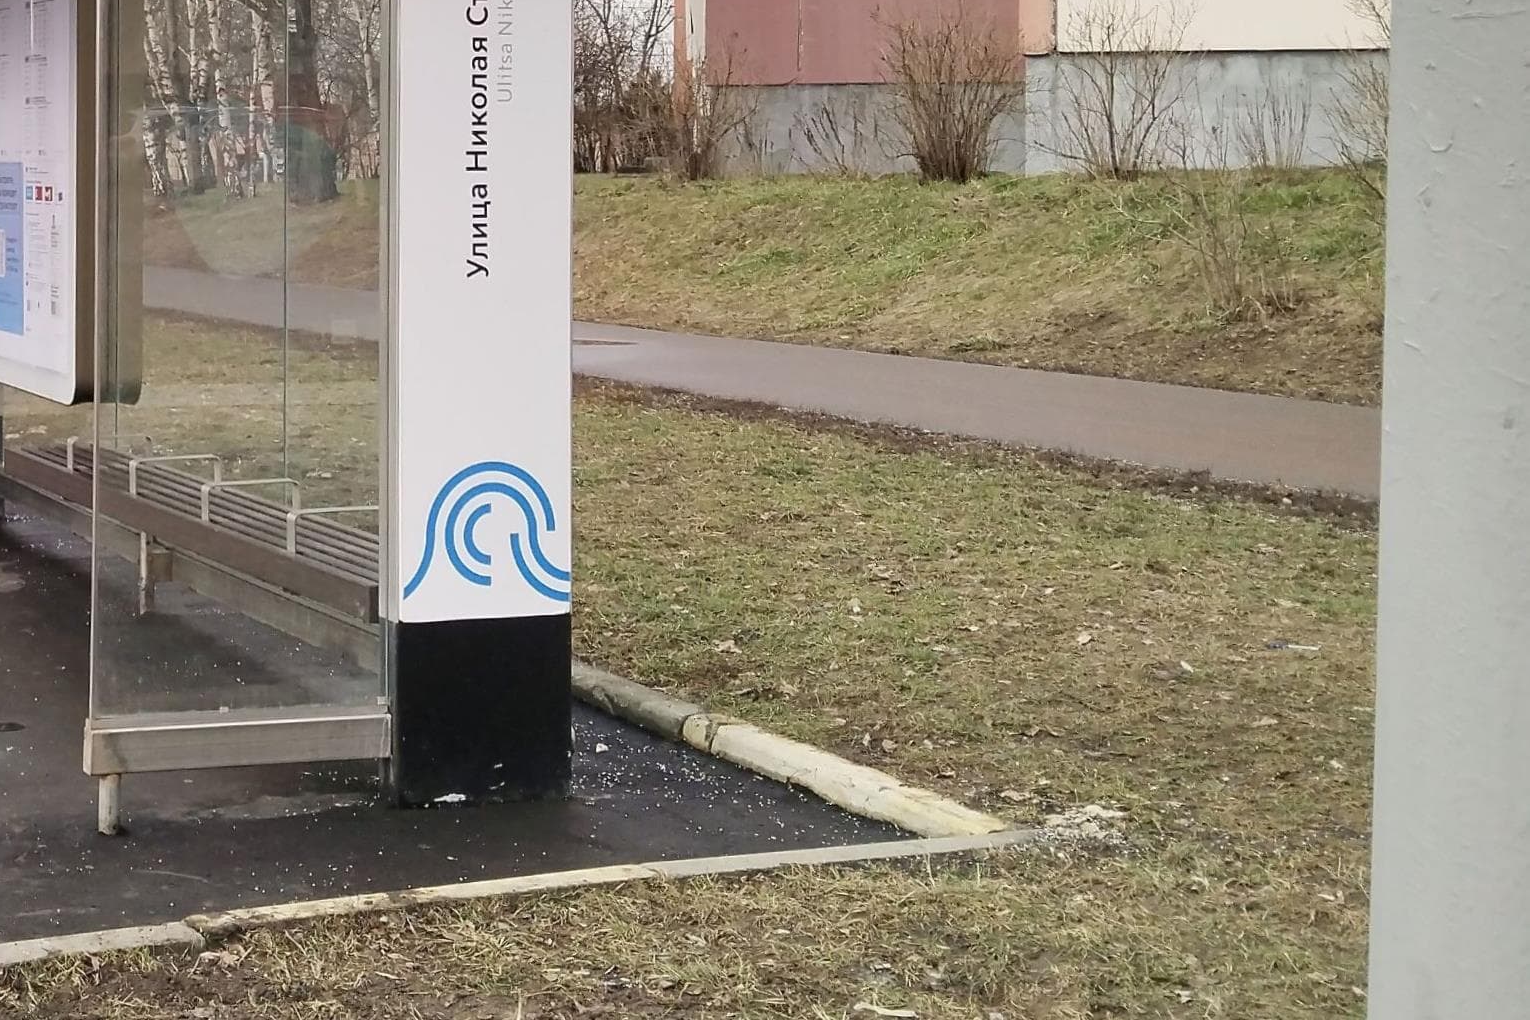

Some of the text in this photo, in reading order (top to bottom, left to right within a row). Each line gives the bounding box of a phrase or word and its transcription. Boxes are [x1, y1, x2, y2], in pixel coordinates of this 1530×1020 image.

[465, 36, 489, 172] Николая
[497, 43, 514, 103] Ulitsa
[465, 184, 492, 279] Улица
